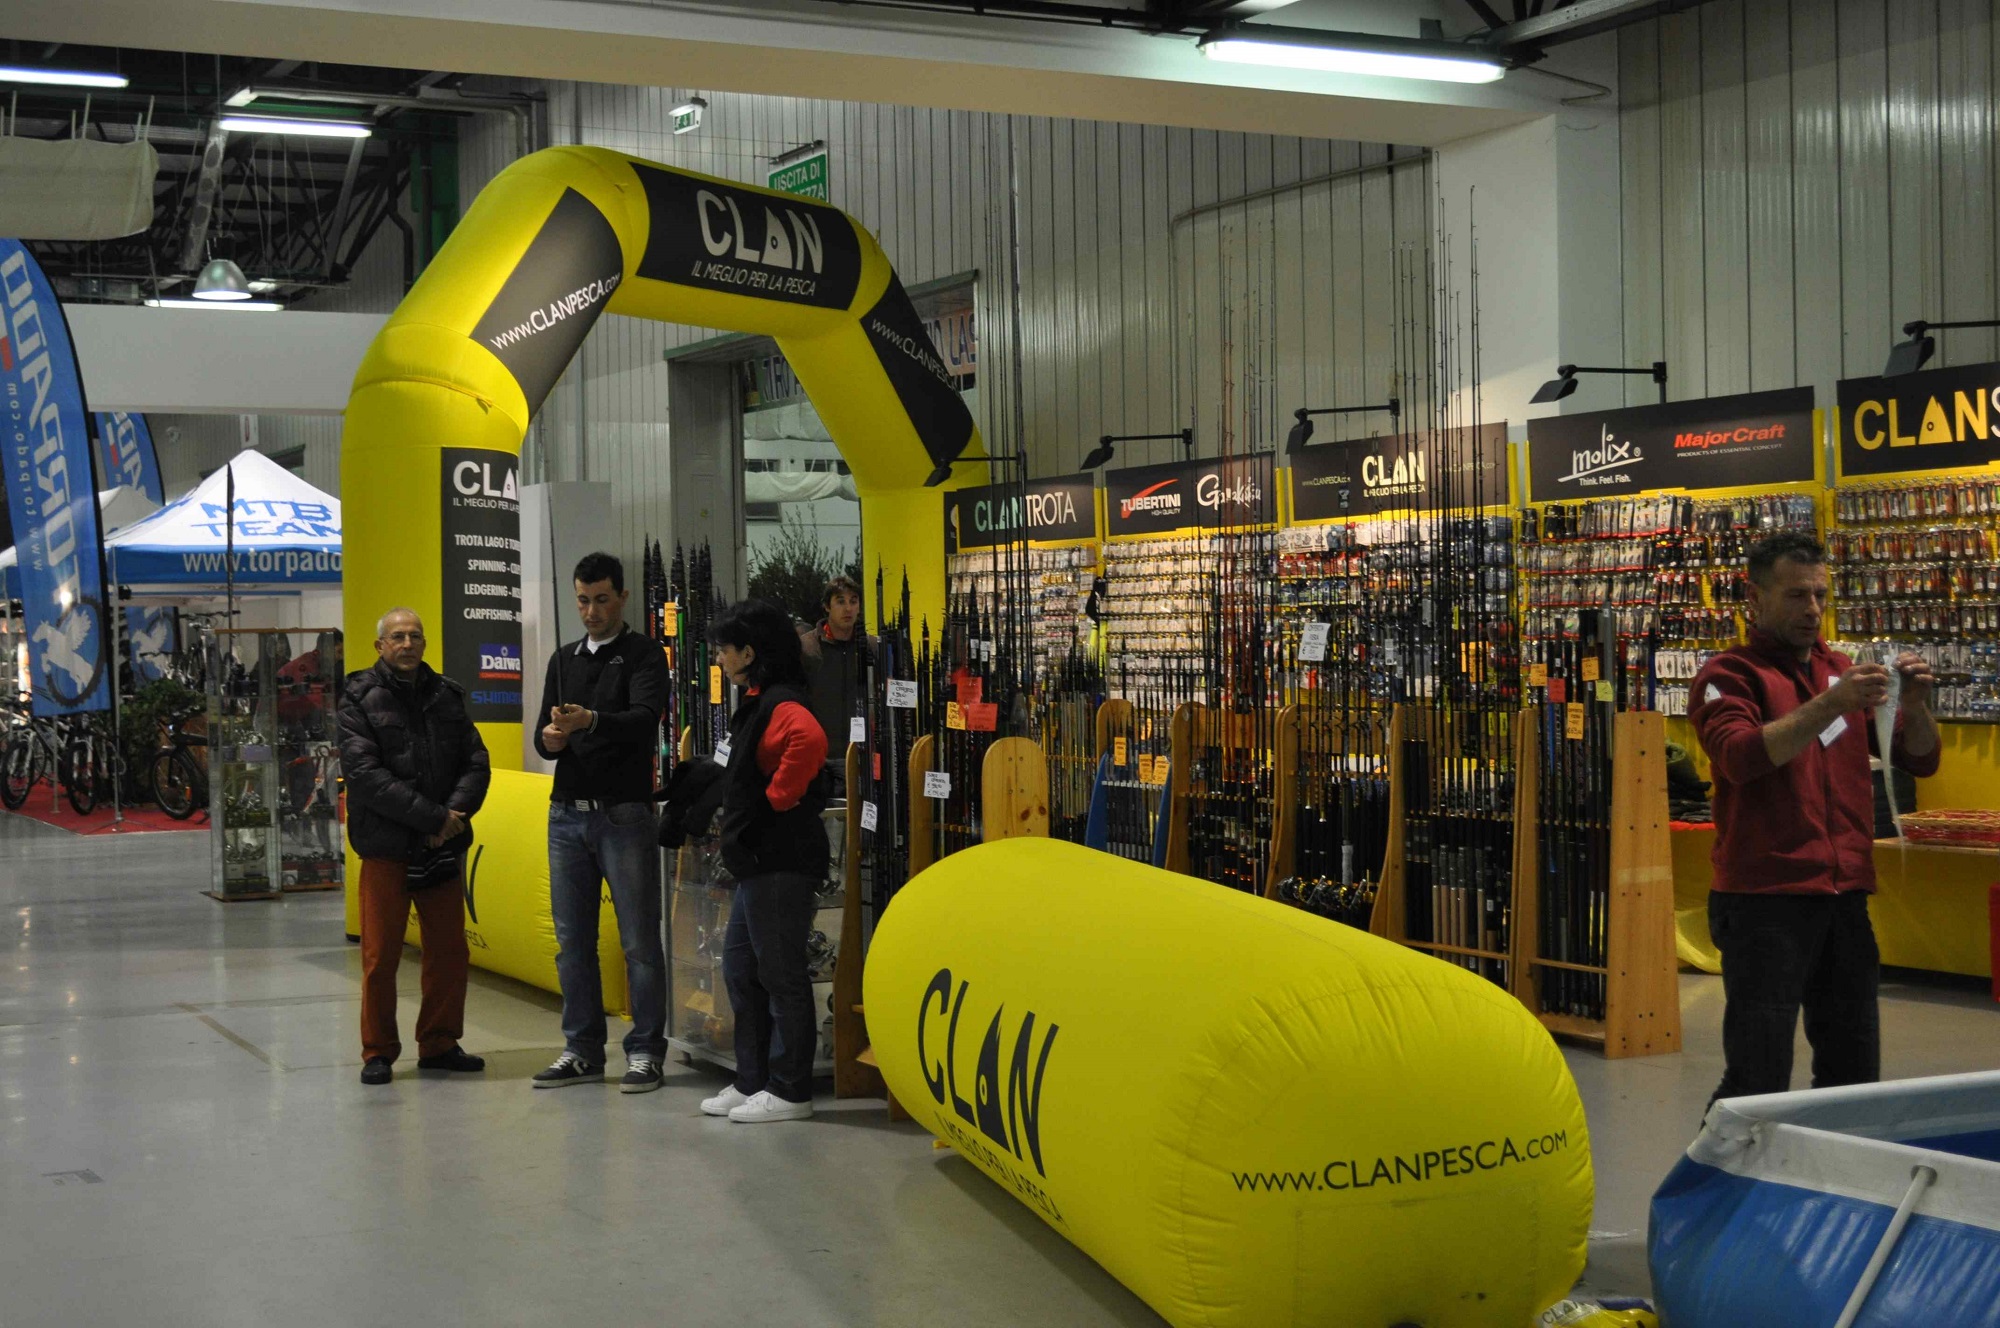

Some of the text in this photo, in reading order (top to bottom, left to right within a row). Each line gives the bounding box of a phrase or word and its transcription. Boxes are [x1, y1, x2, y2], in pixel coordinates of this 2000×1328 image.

[774, 162, 821, 190] USCITA DI
[697, 189, 823, 275] CLAN
[692, 260, 817, 297] IL MEGLIO PER LA PESCA
[453, 460, 519, 500] CLA
[1362, 450, 1426, 487] CLAN
[1120, 493, 1181, 512] TUBERTINI
[454, 534, 484, 547] TROTA
[484, 536, 504, 548] LAGO
[468, 559, 507, 573] SPINNING
[464, 583, 508, 597] LEDGERING
[463, 608, 513, 621] CARPFISHING
[917, 967, 1060, 1180] CLAN
[1231, 1129, 1568, 1192] www.CLANPESCA.COM
